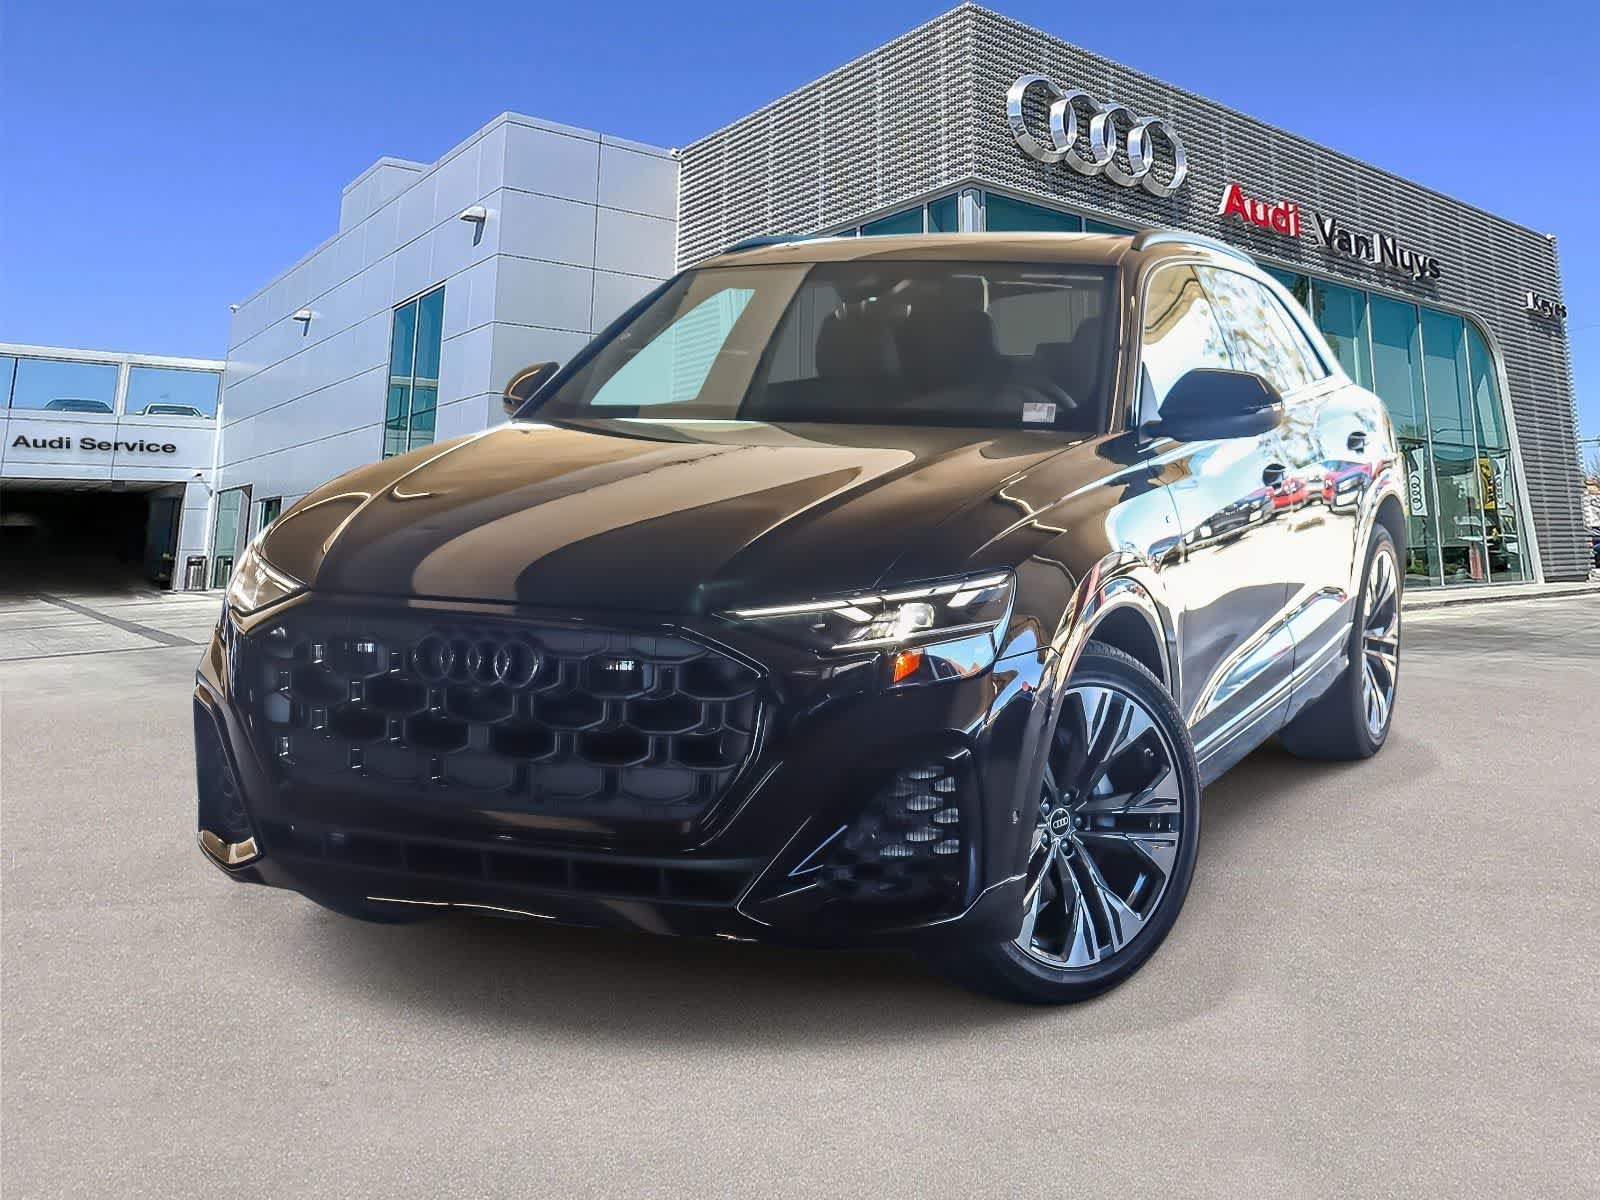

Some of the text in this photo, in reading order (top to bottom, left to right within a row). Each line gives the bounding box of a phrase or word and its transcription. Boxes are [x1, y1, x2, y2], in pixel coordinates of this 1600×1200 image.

[1218, 182, 1441, 280] Audi Van Nuys
[12, 435, 177, 454] Audi Service
